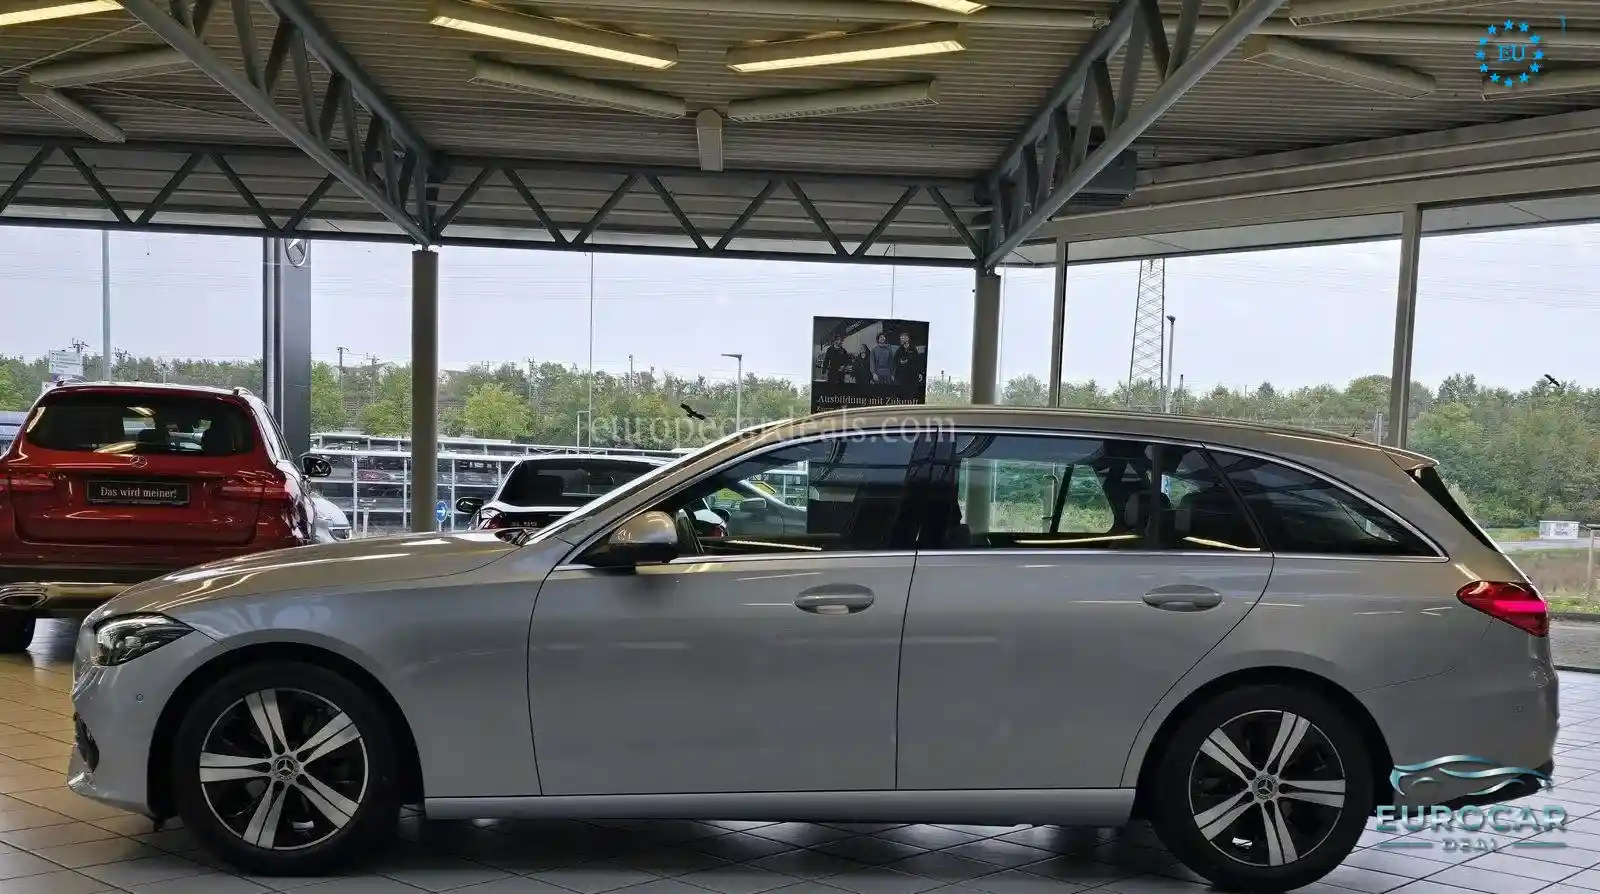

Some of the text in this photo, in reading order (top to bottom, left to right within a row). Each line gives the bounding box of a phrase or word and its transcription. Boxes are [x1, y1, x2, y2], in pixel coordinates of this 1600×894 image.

[818, 393, 867, 406] Ausbildung
[869, 396, 884, 405] mit
[100, 486, 177, 499] Das wird meiner!
